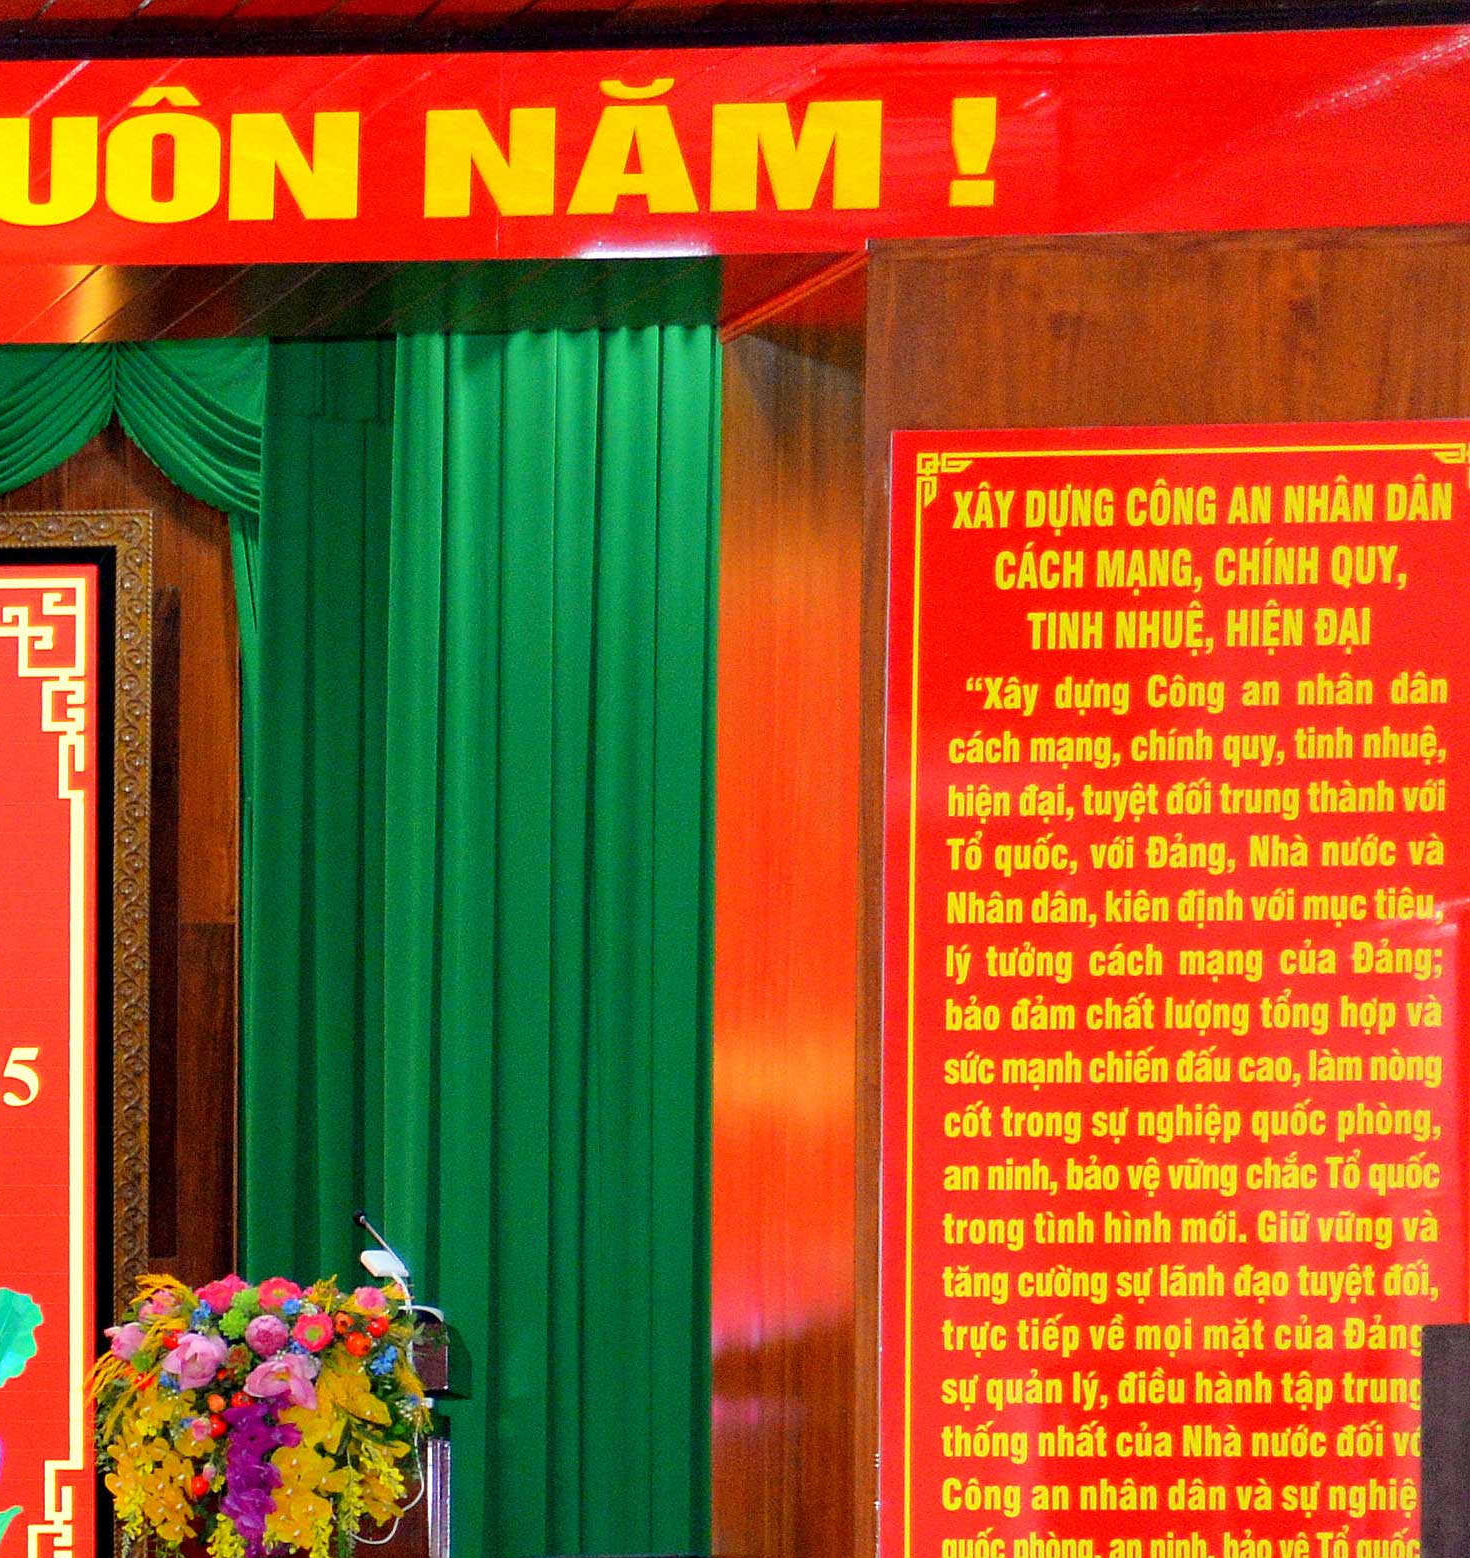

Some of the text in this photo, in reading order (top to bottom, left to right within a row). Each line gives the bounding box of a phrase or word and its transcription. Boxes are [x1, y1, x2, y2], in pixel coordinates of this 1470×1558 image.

[425, 79, 882, 217] NĂM
[950, 98, 996, 206] !
[953, 474, 1452, 535] XÂY DỰNG CÔNG AN NHÂN DÂN
[996, 538, 1406, 595] CÁCH MẠNG, CHÍNH QUY,
[1028, 600, 1370, 656] TINH NHUỆ, HIỆN ĐẠI
[967, 672, 1447, 716] “Xây dựng Công an nhân dân
[949, 726, 1446, 769] cách mạng, chính quy, tinh nhuệ,
[947, 939, 1442, 984] lý tưởng cách mạng của Đảng;
